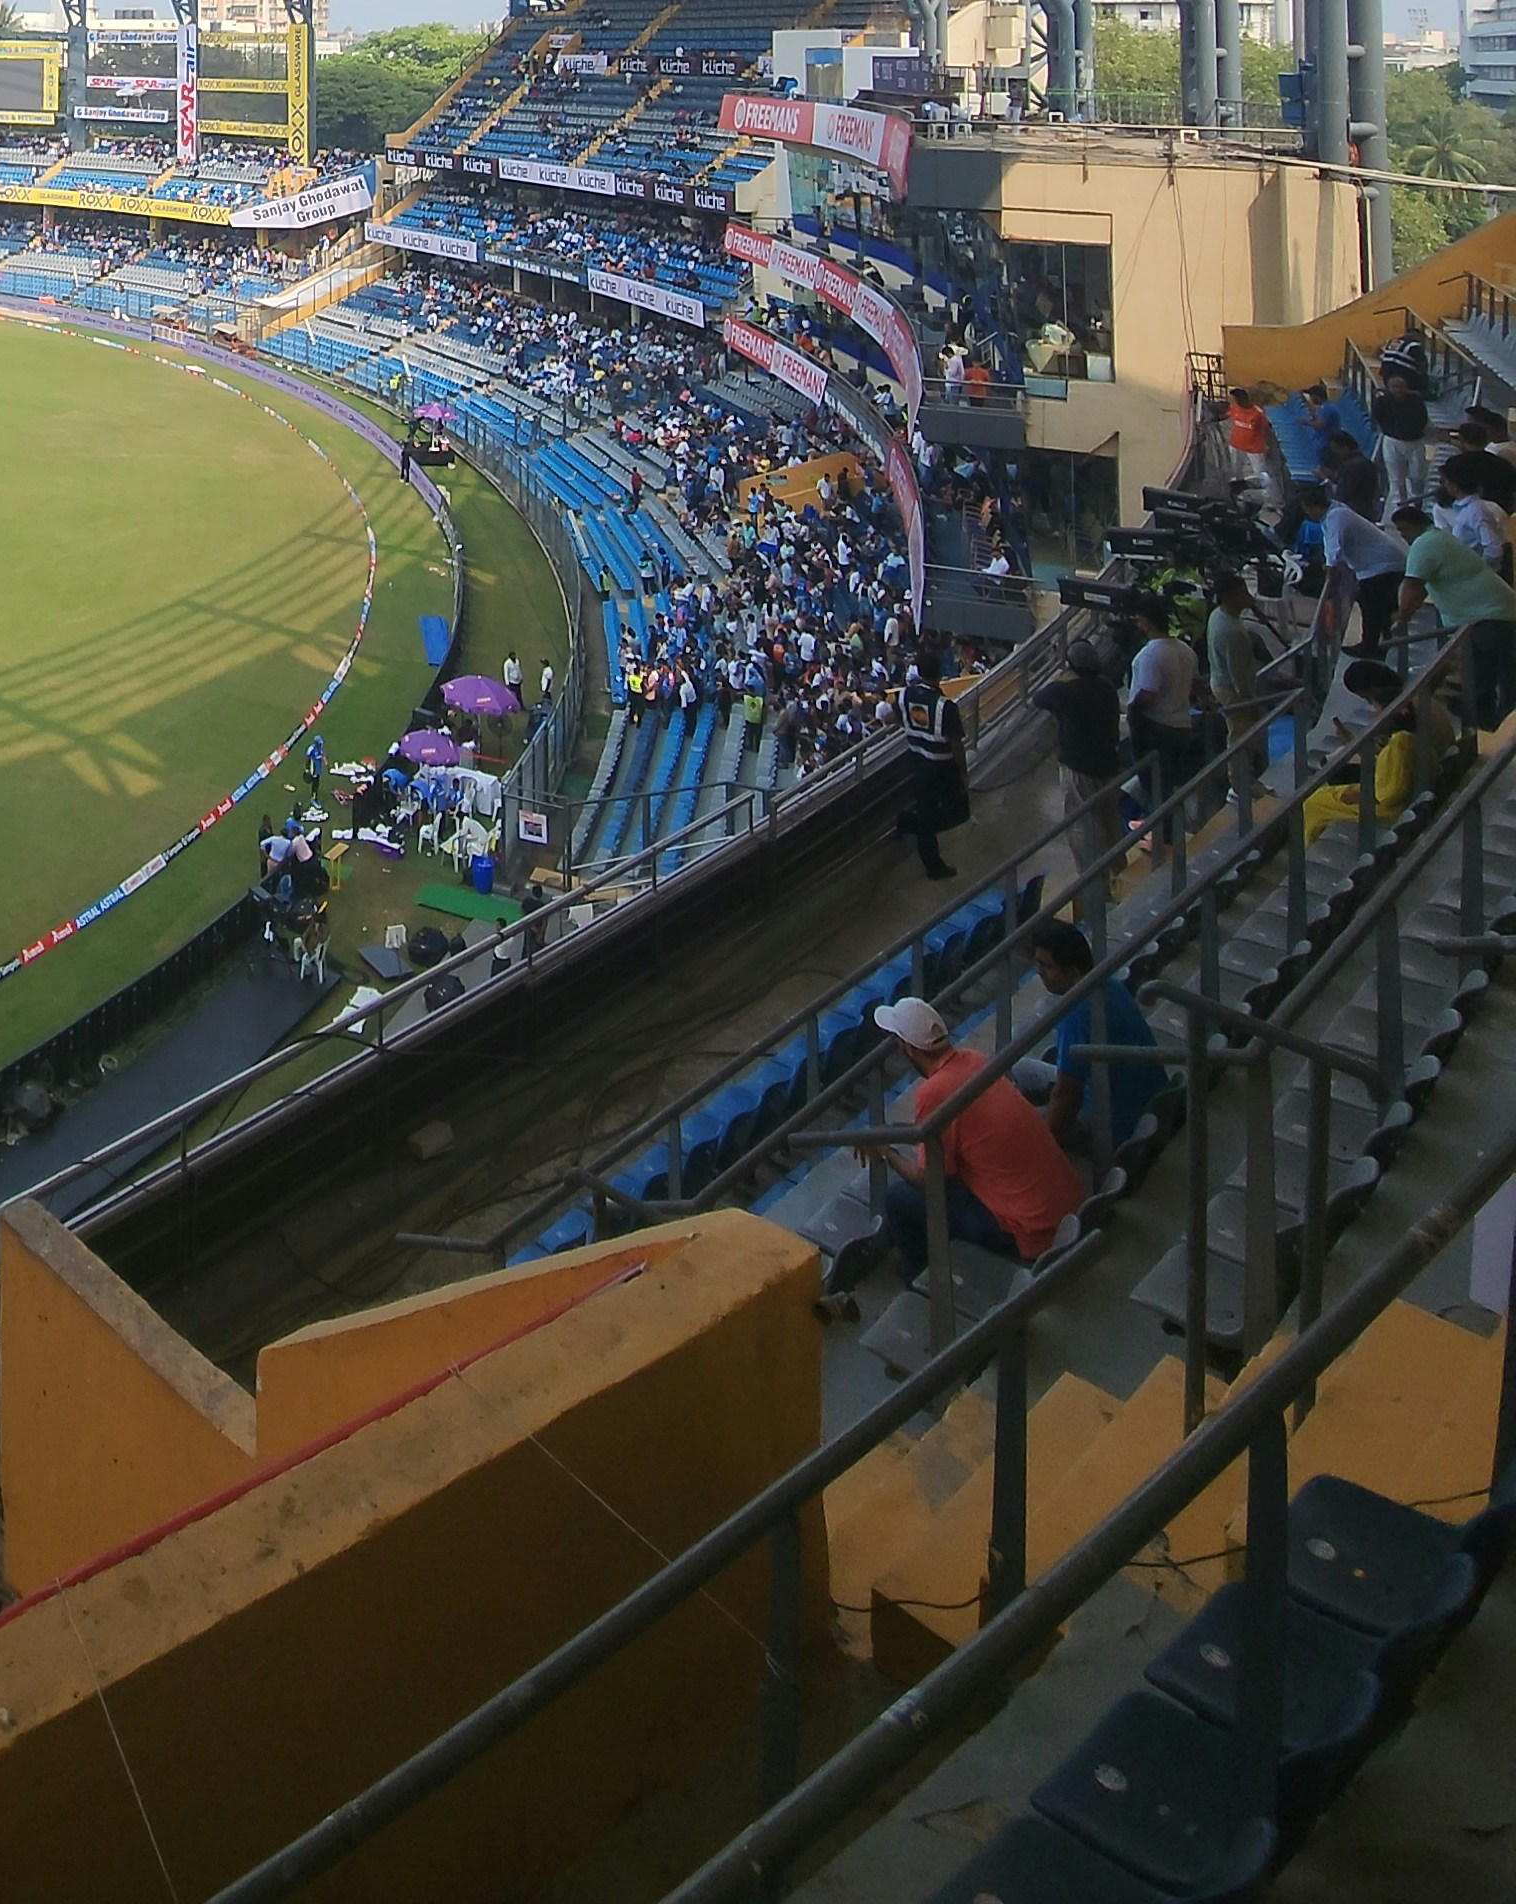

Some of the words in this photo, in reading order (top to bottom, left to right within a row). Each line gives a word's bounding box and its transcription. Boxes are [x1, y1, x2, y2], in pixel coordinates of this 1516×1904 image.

[156, 33, 177, 43] Group
[294, 28, 302, 98] GLASSWARE
[562, 55, 594, 74] küche
[660, 58, 691, 75] küche
[702, 58, 736, 76] küche
[144, 110, 165, 121] Group
[744, 102, 800, 135] FREEMANS
[833, 112, 874, 152] FREEMANS
[387, 148, 416, 166] küche
[425, 152, 453, 170] küche
[463, 157, 492, 174] küche
[500, 161, 528, 179] küche
[539, 166, 567, 184] küche
[578, 171, 606, 190] küche
[616, 177, 645, 197] küche
[654, 183, 684, 204] küche
[694, 189, 726, 211] küche
[79, 193, 114, 208] ROXX
[120, 197, 152, 213] ROXX
[191, 205, 226, 222] ROXX
[253, 201, 296, 222] Sanjay
[298, 175, 365, 208] Ghodawat
[297, 201, 336, 223] Group
[366, 225, 392, 243] küche
[403, 232, 429, 250] küche
[440, 239, 469, 257] küche
[732, 231, 771, 260] FREEMANS
[778, 250, 817, 284] FREEMANS
[822, 267, 857, 309] FREEMANS
[590, 273, 617, 296] küche
[628, 284, 655, 307] küche
[664, 296, 694, 320] küche
[732, 321, 774, 361] FREEMANS
[781, 358, 825, 398] FREEMANS
[75, 907, 100, 930] ASTRAL
[99, 889, 125, 912] ASTRAL
[23, 940, 46, 964] Amul
